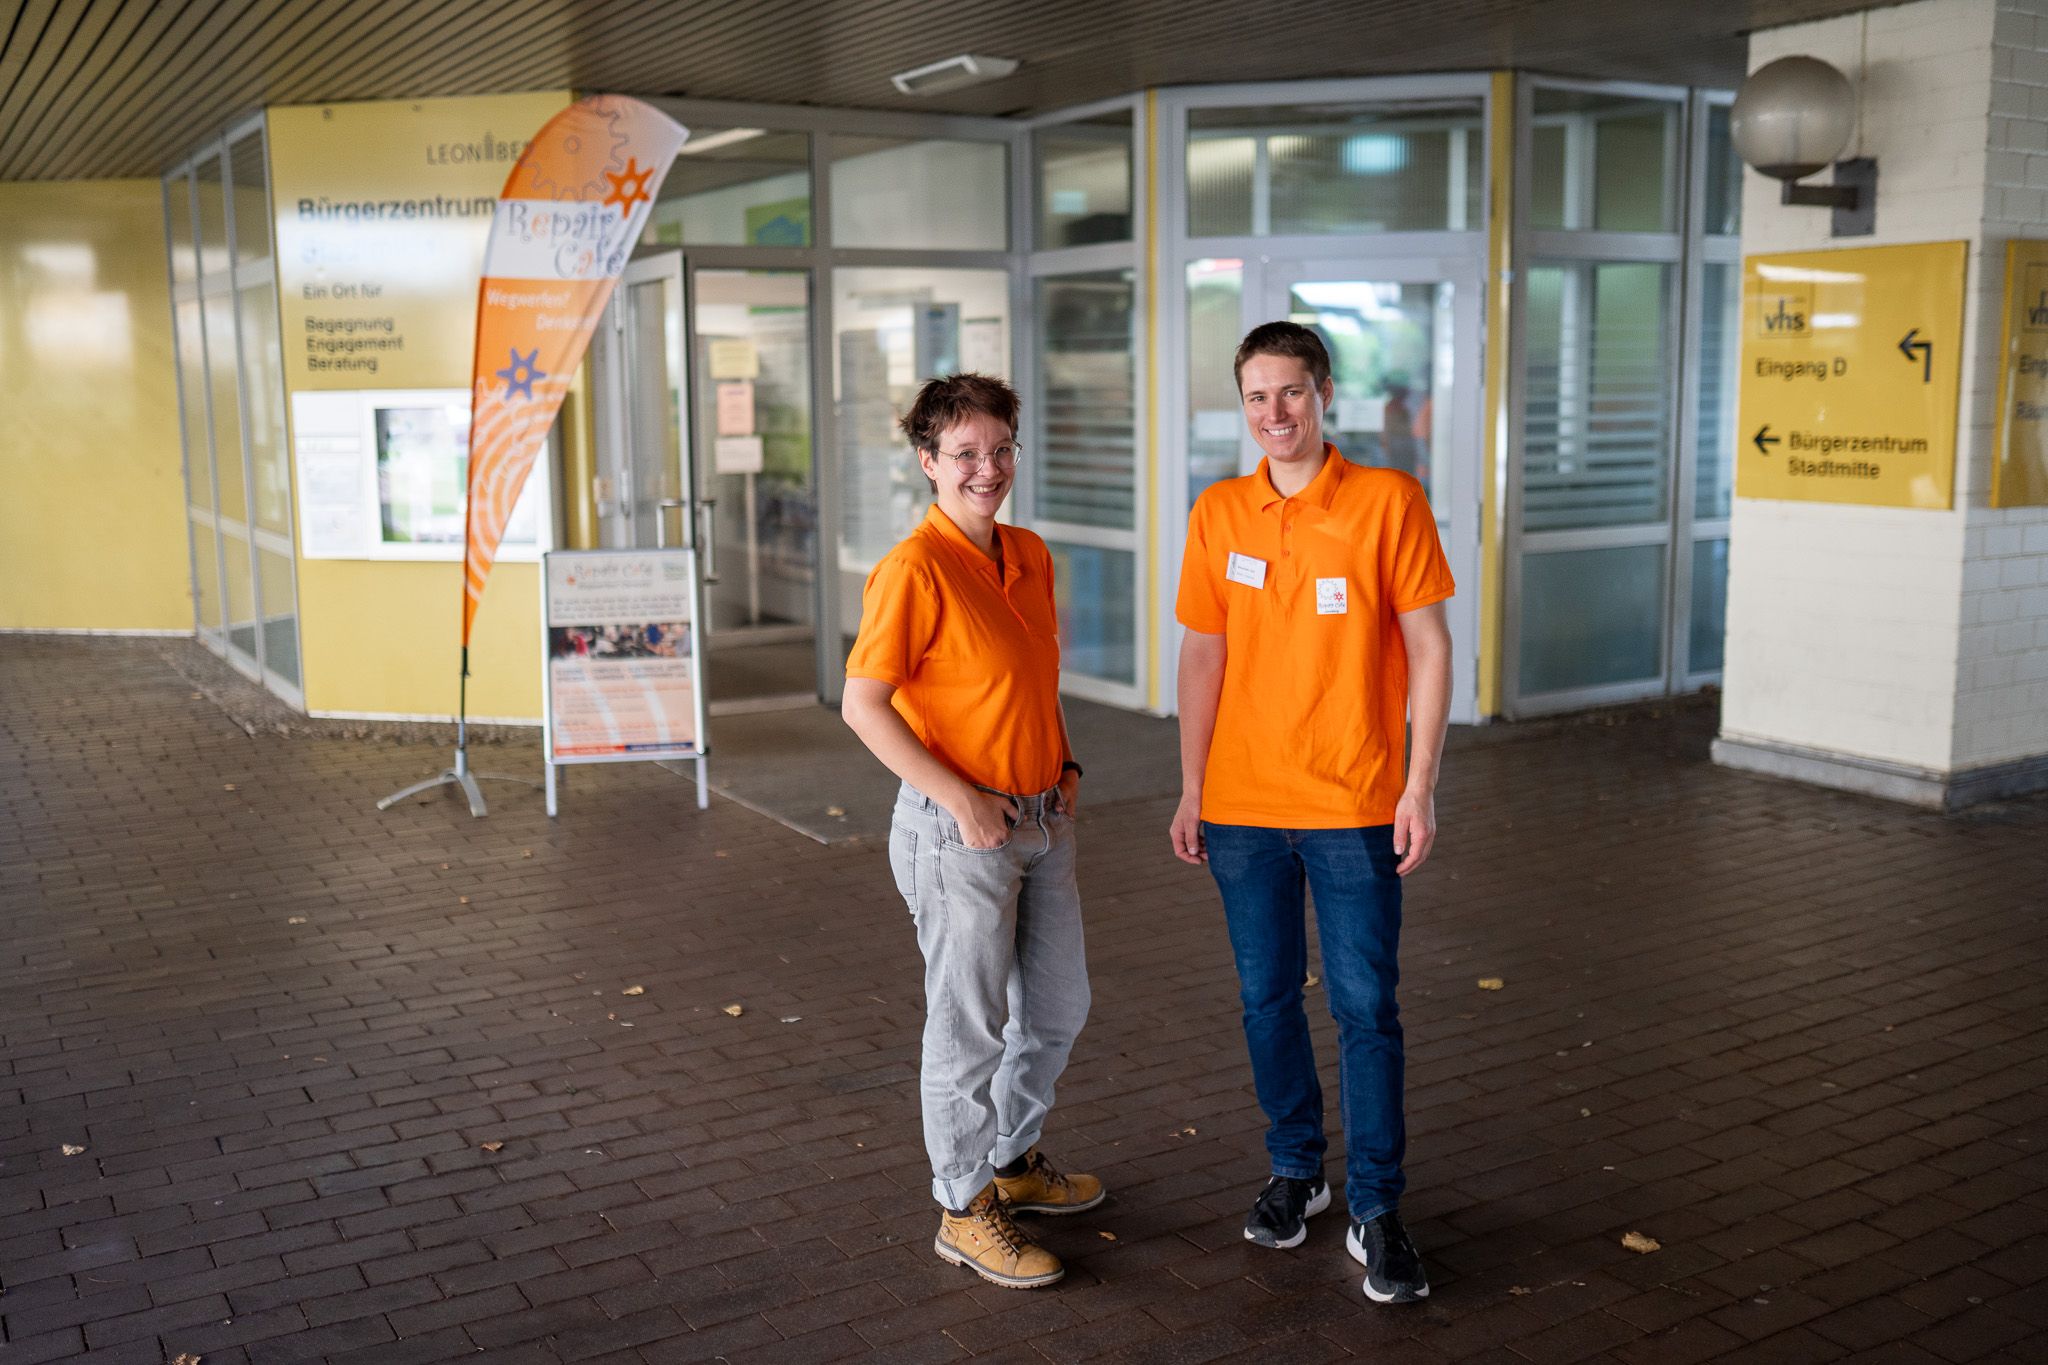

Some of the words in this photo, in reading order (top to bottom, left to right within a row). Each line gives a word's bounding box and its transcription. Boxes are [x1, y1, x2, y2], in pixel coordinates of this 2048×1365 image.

[298, 196, 496, 222] Bürgerzentrum
[507, 201, 614, 247] Repair
[332, 282, 356, 299] Ort
[1765, 297, 1804, 332] vhs
[306, 335, 404, 354] Engagement
[308, 355, 378, 374] Beratung
[1756, 357, 1827, 381] Eingang
[1833, 356, 1847, 376] D
[1789, 431, 1927, 454] Bürgerzentrum
[1788, 457, 1880, 478] Stadtmitte
